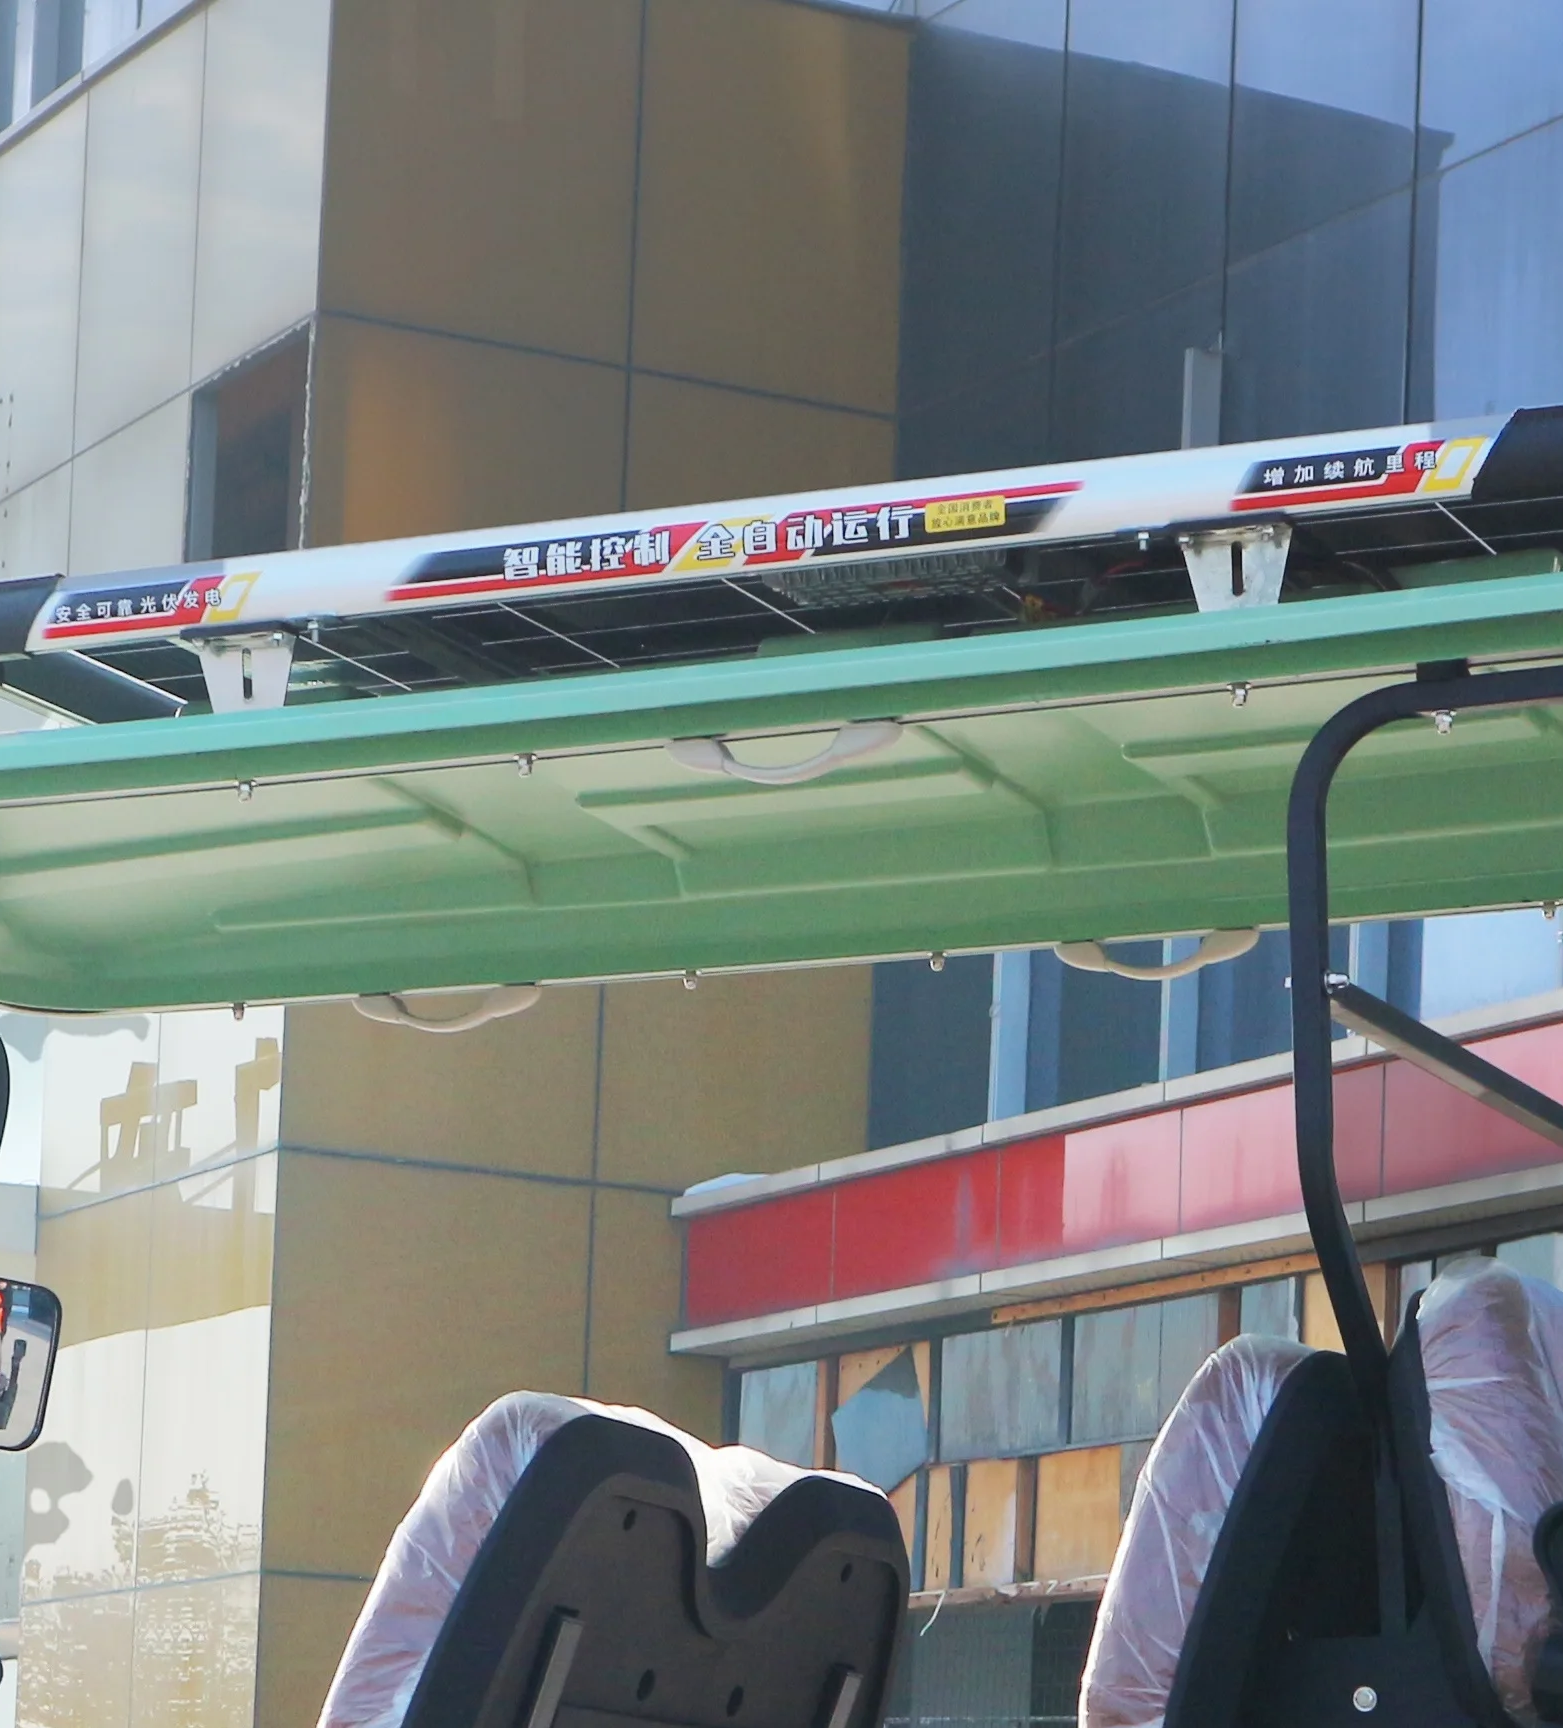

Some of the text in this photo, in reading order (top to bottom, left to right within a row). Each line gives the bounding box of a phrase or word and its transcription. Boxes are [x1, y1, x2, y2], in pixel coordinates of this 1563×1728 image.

[1263, 450, 1438, 487] 增加续航里程
[503, 504, 914, 580] 智能控制 全自动运行
